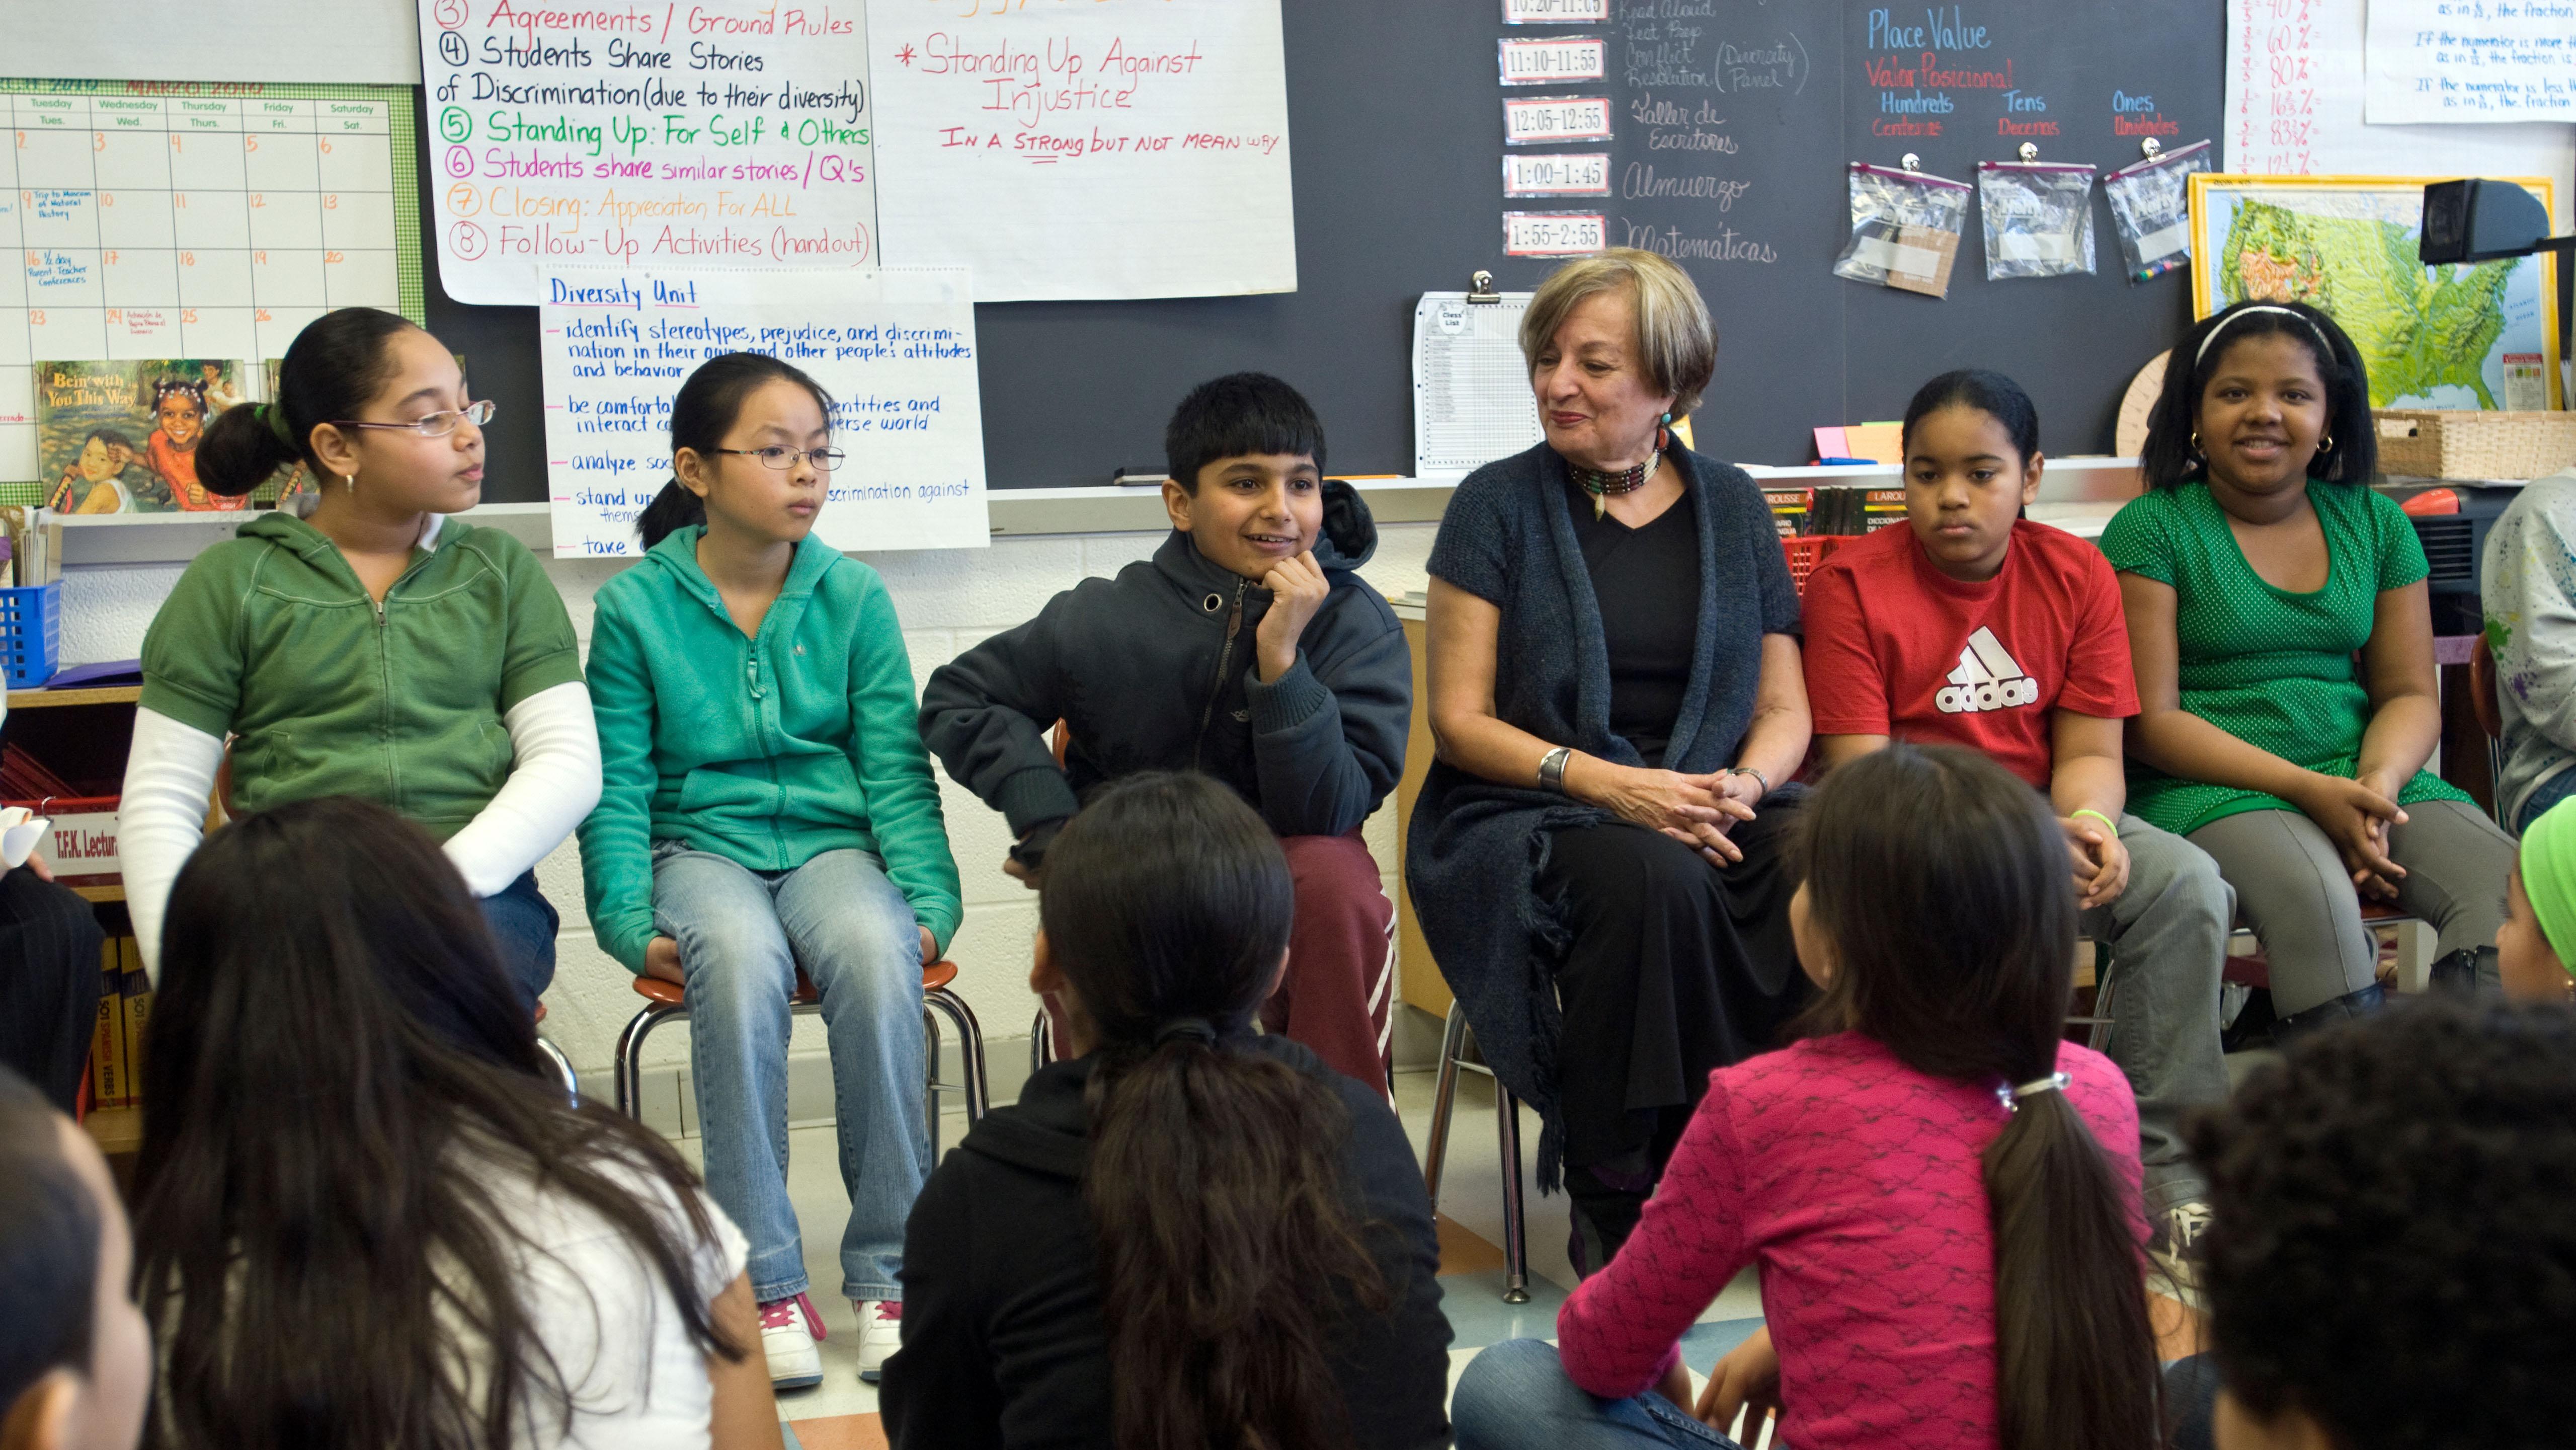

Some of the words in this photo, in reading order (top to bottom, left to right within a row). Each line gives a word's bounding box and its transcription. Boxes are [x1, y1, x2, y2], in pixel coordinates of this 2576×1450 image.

[2497, 2, 2518, 17] the
[487, 0, 652, 51] Agreements
[689, 3, 774, 36] Ground
[785, 9, 853, 37] Rules
[1868, 7, 1926, 50] Place
[1927, 4, 1991, 50] Value
[480, 36, 592, 68] Students
[608, 35, 672, 69] Share
[690, 42, 764, 71] Stories
[922, 33, 1040, 88] Standing
[1048, 36, 1082, 85] Up
[1099, 36, 1202, 95] Against
[1509, 49, 1597, 72] 11:10-11:55
[2489, 51, 2507, 64] the
[1865, 56, 1915, 88] Valor
[1921, 52, 2013, 89] Posicional
[31, 99, 72, 109] Tuesday
[99, 101, 157, 111] Wednesday
[182, 101, 227, 113] Thursday
[264, 103, 293, 113] Friday
[330, 104, 373, 115] Saturday
[437, 73, 459, 102] of
[697, 82, 717, 105] to
[725, 77, 769, 109] their
[779, 78, 865, 124] diversity)
[982, 78, 1133, 128] Injustice
[1632, 92, 1689, 125] Taller
[1694, 99, 1727, 124] de
[1881, 91, 1954, 114] Hundreds
[2002, 88, 2046, 113] Tens
[2113, 89, 2154, 112] Ones
[40, 116, 65, 125] Tues.
[116, 118, 142, 127] Wed.
[190, 118, 219, 128] Thurs.
[272, 120, 287, 129] Fri.
[344, 121, 362, 130] Sat.
[1514, 108, 1601, 132] 12:05-12:55
[1872, 117, 1944, 136] Centenas
[1998, 117, 2061, 136] Decenas
[2115, 115, 2180, 136] Unidades
[17, 131, 28, 148] 2
[94, 133, 105, 151] 3
[172, 134, 181, 153] 4
[246, 135, 258, 152] 5
[320, 136, 332, 154] 6
[489, 112, 602, 156] Standing
[613, 116, 656, 156] Up:
[664, 115, 702, 145] For
[713, 116, 766, 146] Self
[798, 119, 870, 146] Others
[987, 132, 1002, 149] A
[1135, 136, 1174, 152] NOT
[1649, 125, 1738, 154] Escritores
[483, 148, 584, 179] Students
[594, 151, 653, 180] share
[661, 152, 726, 181] similar
[732, 158, 798, 182] stories
[820, 155, 865, 183] Q's
[1516, 163, 1601, 184] 1:00-1:45
[1623, 161, 1750, 212] Almuerzo
[22, 191, 31, 209] 9
[100, 193, 114, 207] 10
[175, 193, 186, 208] 11
[249, 193, 266, 208] 12
[323, 194, 338, 210] 13
[490, 188, 590, 234] Closing:
[598, 191, 708, 227] Appreciation
[717, 191, 747, 216] For
[751, 191, 797, 217] ALL
[500, 226, 639, 265] Follow-Up
[652, 225, 762, 256] Activities
[770, 222, 869, 267] (handout)
[1513, 224, 1598, 246] 1:55-2:55
[27, 251, 40, 266] 16
[104, 251, 119, 265] 17
[180, 252, 195, 266] 18
[254, 251, 267, 265] 19
[325, 252, 344, 263] 20
[55, 252, 71, 267] day
[550, 277, 642, 311] Diversity
[654, 279, 698, 304] Unit
[30, 310, 46, 325] 23
[106, 309, 123, 325] 24
[182, 309, 198, 324] 25
[256, 309, 272, 322] 26
[566, 314, 639, 343] identify
[649, 317, 755, 345] stereotypes,
[760, 326, 841, 344] prejudice,
[847, 322, 878, 341] and
[886, 321, 963, 341] discrimi-
[568, 343, 629, 359] nation
[633, 342, 650, 359] in
[656, 341, 699, 359] their
[748, 342, 777, 358] and
[785, 341, 828, 359] other
[835, 341, 897, 362] people's
[904, 342, 971, 359] attitudes
[92, 373, 124, 388] with
[573, 363, 607, 377] and
[615, 362, 684, 378] behavior
[47, 389, 72, 407] You
[74, 389, 104, 406] This
[105, 388, 137, 408] Way
[569, 396, 591, 414] be
[908, 396, 940, 413] and
[577, 415, 658, 433] interact
[880, 414, 928, 431] world
[572, 454, 637, 473] analyze
[576, 488, 626, 506] stand
[918, 482, 970, 504] against
[582, 539, 632, 556] take
[1935, 677, 2039, 713] addas
[103, 1064, 115, 1096] VERBS
